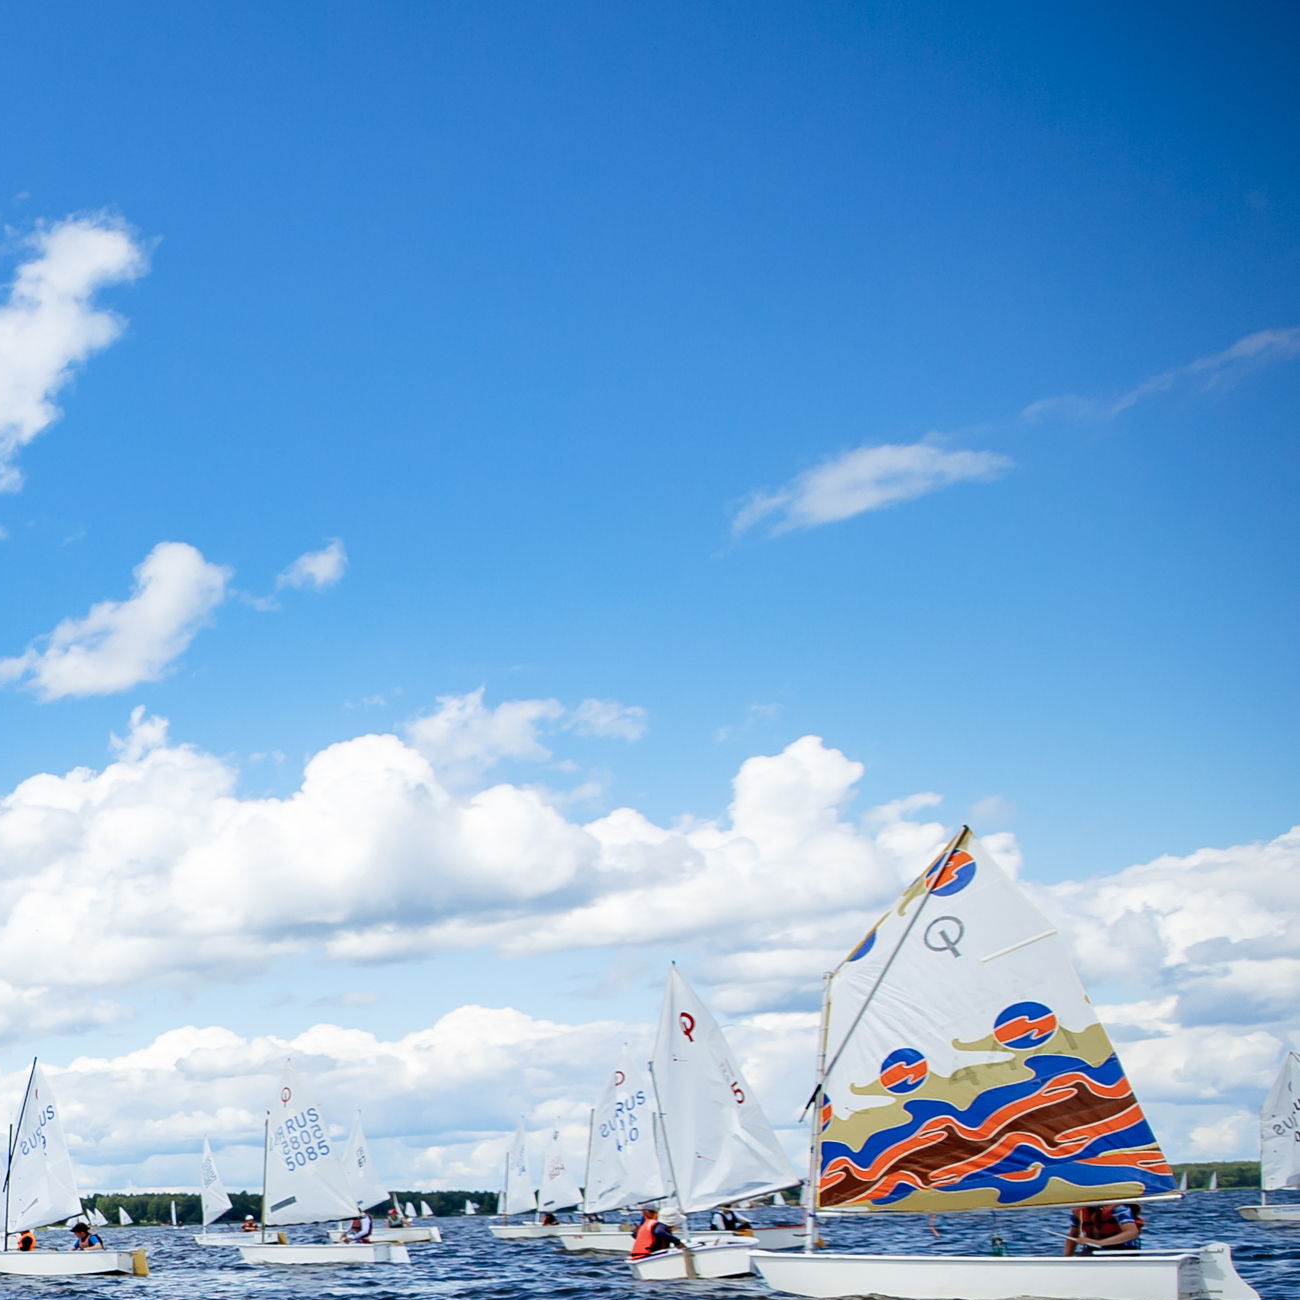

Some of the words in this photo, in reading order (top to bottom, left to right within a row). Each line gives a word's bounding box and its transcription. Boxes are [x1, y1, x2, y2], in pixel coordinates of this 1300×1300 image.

[615, 1091, 646, 1118] RUS
[285, 1107, 319, 1134] RUS
[286, 1140, 330, 1172] 5085
